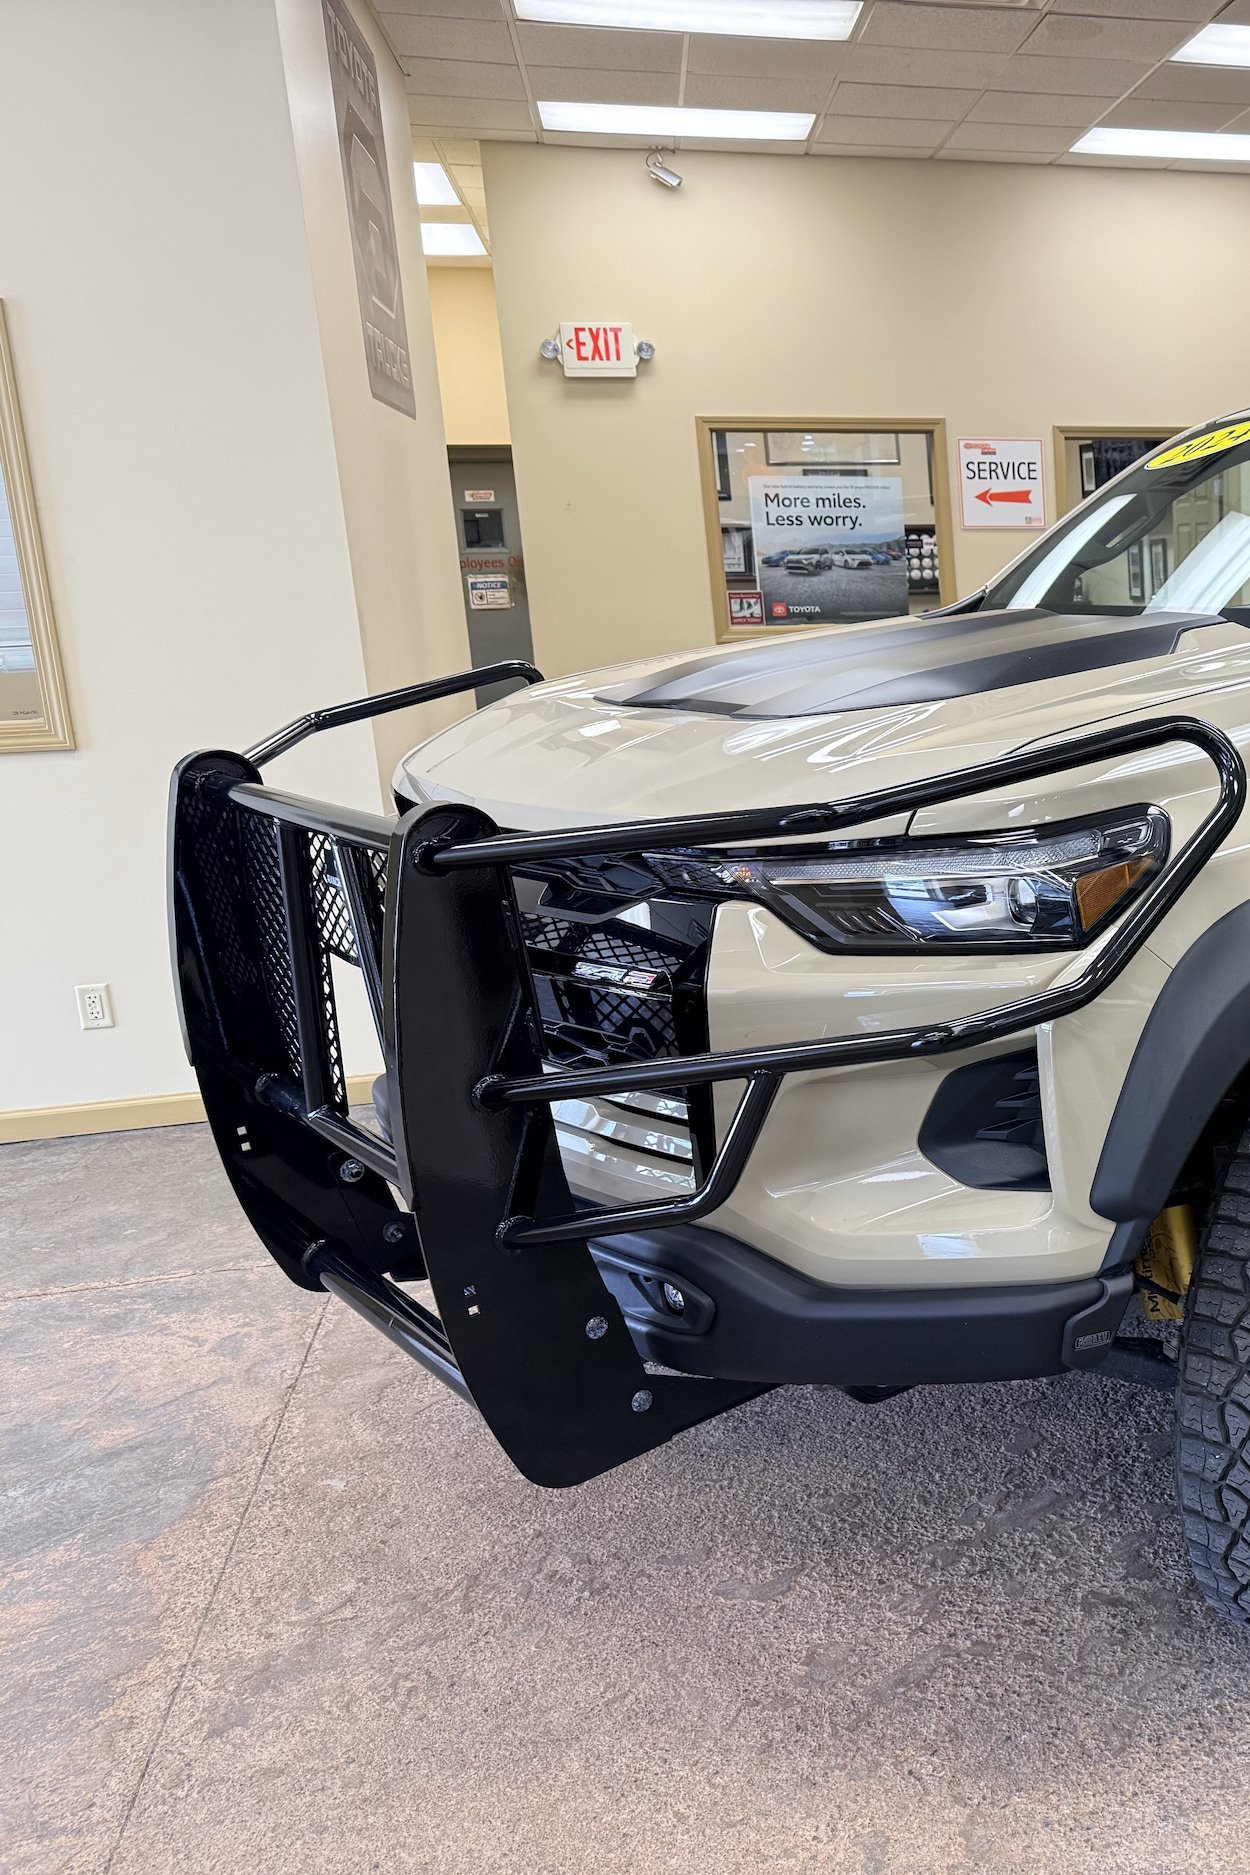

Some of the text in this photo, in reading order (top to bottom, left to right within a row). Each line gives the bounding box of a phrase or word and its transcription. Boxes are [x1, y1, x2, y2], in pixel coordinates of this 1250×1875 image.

[574, 327, 622, 361] EXIT
[966, 461, 1038, 480] SERVICE
[765, 493, 866, 508] More miles.
[766, 511, 862, 529] Less worry.
[788, 605, 821, 613] TOYOTA
